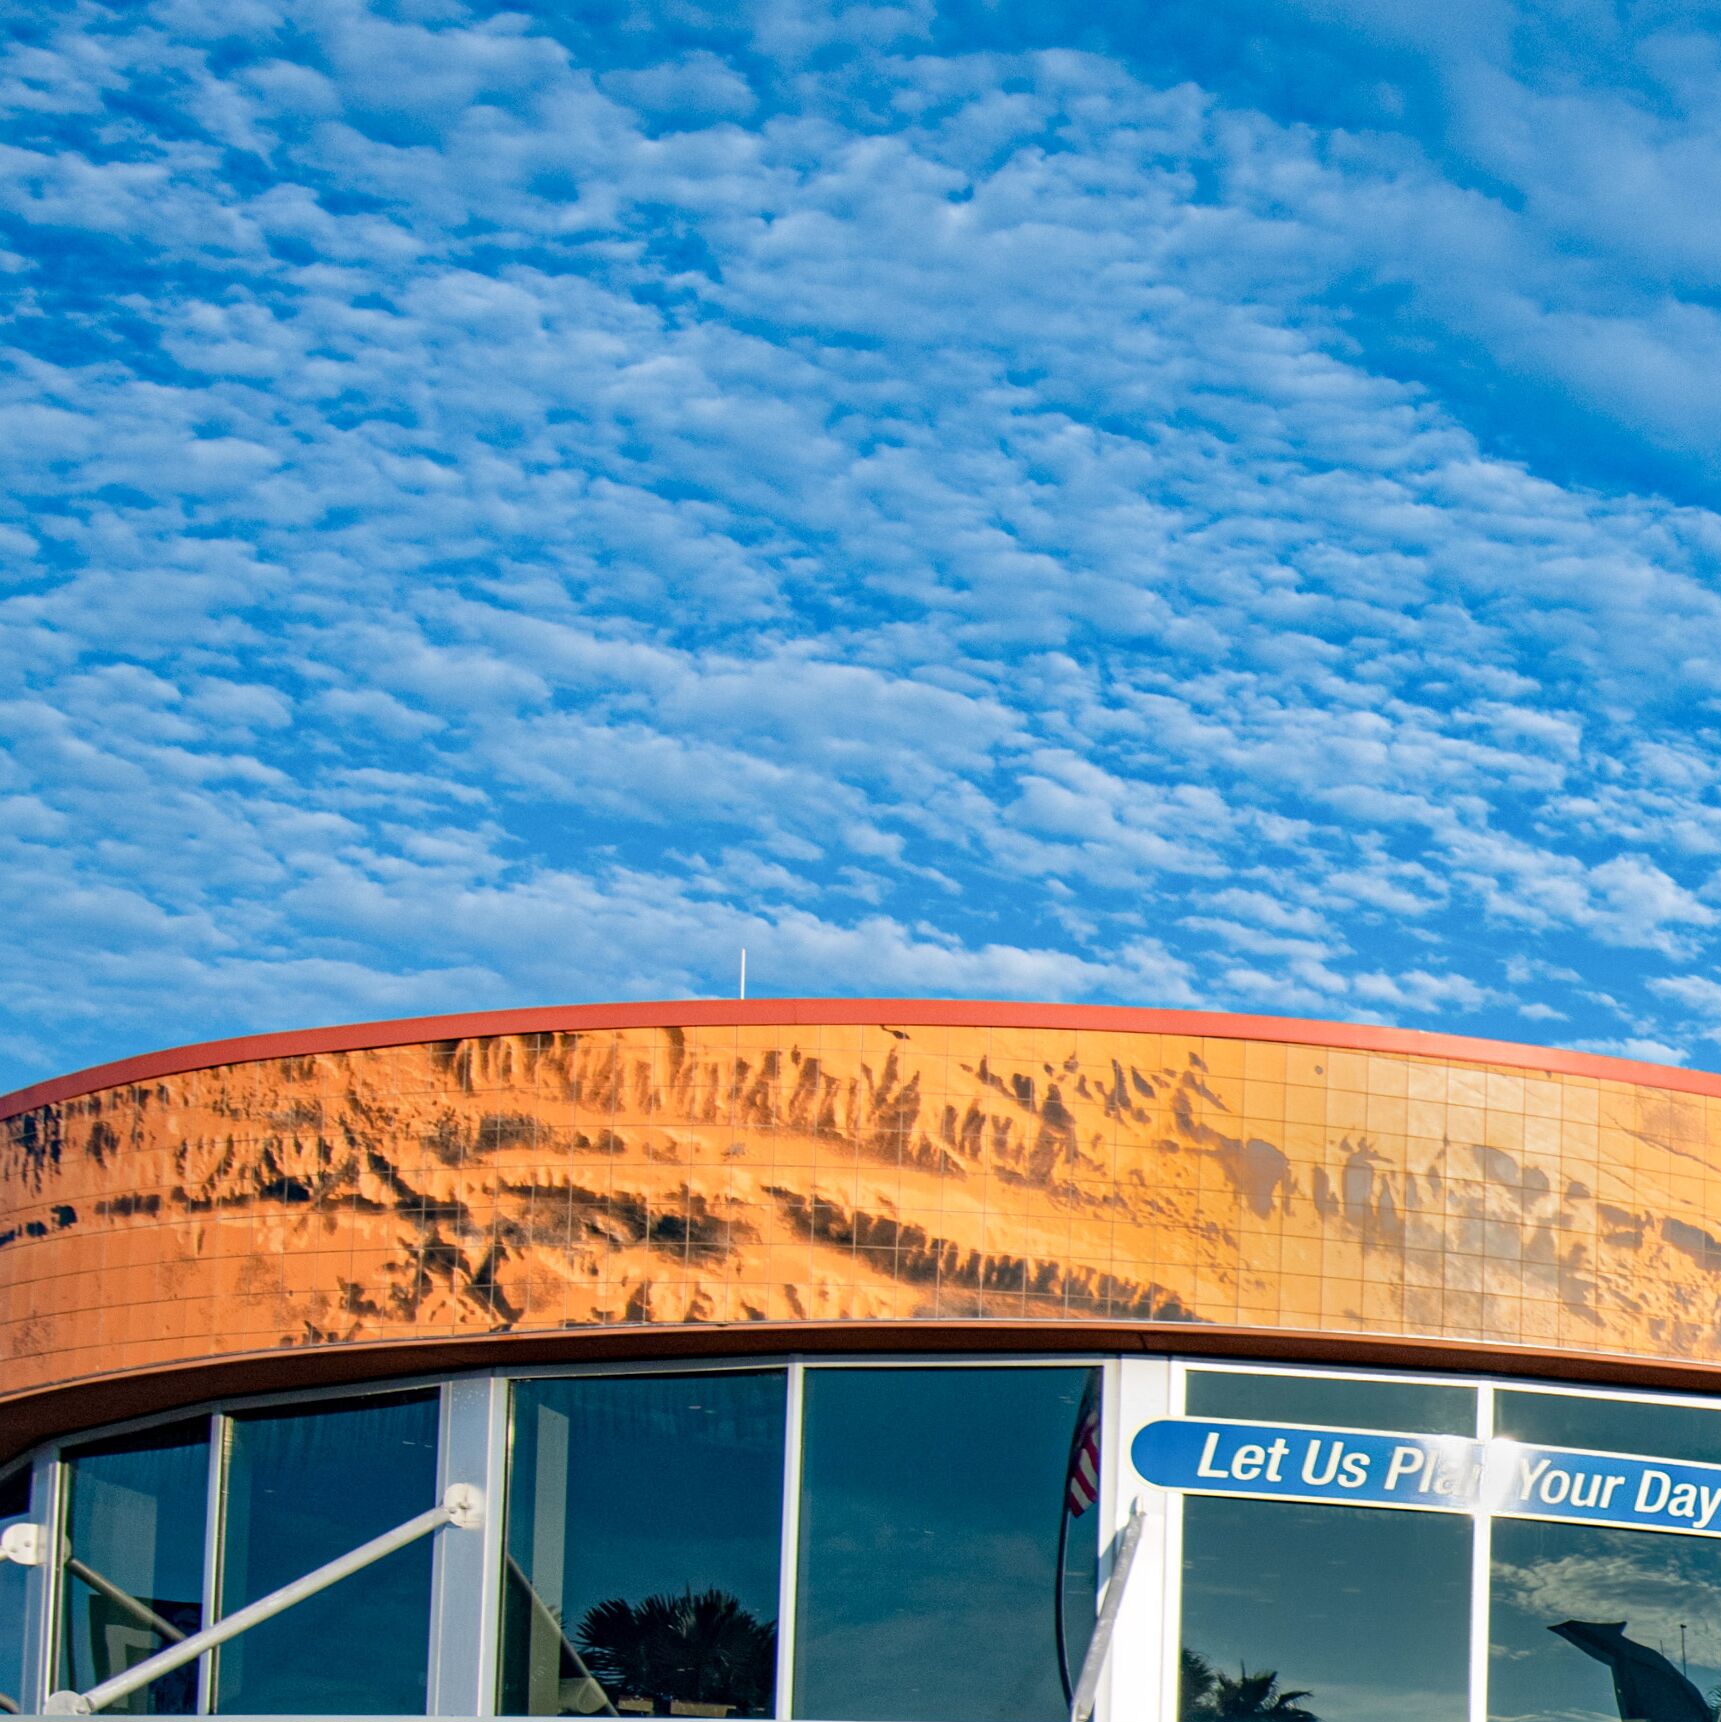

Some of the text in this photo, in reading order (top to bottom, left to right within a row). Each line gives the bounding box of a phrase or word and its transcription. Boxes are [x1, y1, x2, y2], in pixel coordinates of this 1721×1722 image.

[1197, 1432, 1290, 1484] Let
[1301, 1440, 1368, 1490] Us
[1519, 1457, 1626, 1509] Your
